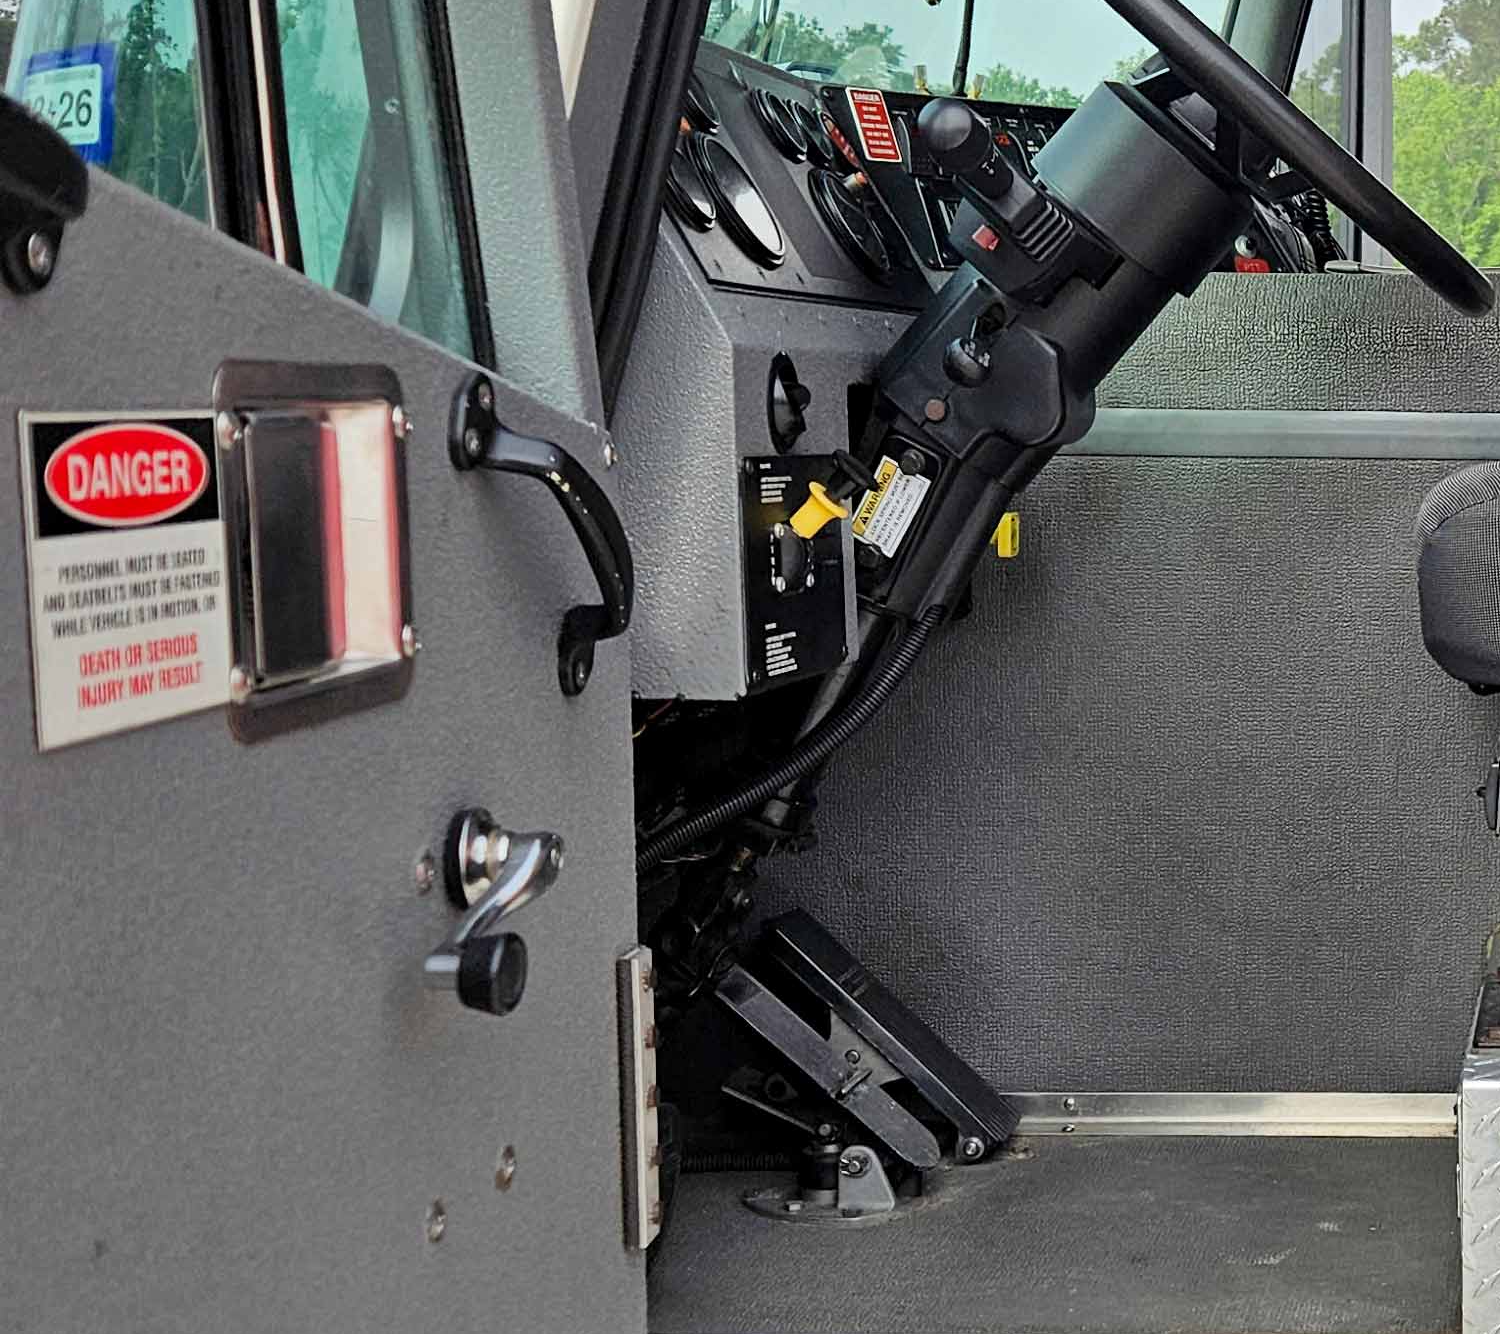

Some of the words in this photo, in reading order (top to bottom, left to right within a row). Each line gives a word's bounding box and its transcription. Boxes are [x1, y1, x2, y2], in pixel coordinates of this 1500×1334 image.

[66, 449, 192, 502] DANGER
[58, 559, 123, 584] PERSONNEL
[125, 554, 152, 573] MUST
[156, 553, 168, 568] BE
[43, 594, 65, 613] AND
[68, 584, 127, 609] SEATBELTS
[129, 579, 156, 599] MUST
[160, 577, 172, 594] BE
[52, 620, 87, 640] WHILE
[90, 610, 130, 633] VEHICLE
[134, 607, 145, 623] IS
[147, 605, 158, 621] IN
[79, 646, 120, 676] DEATH
[125, 644, 142, 667] OR
[146, 632, 198, 662] SERIOUS
[78, 679, 124, 708] INJURY
[129, 674, 154, 697] MAY
[159, 662, 203, 689] RESULT
